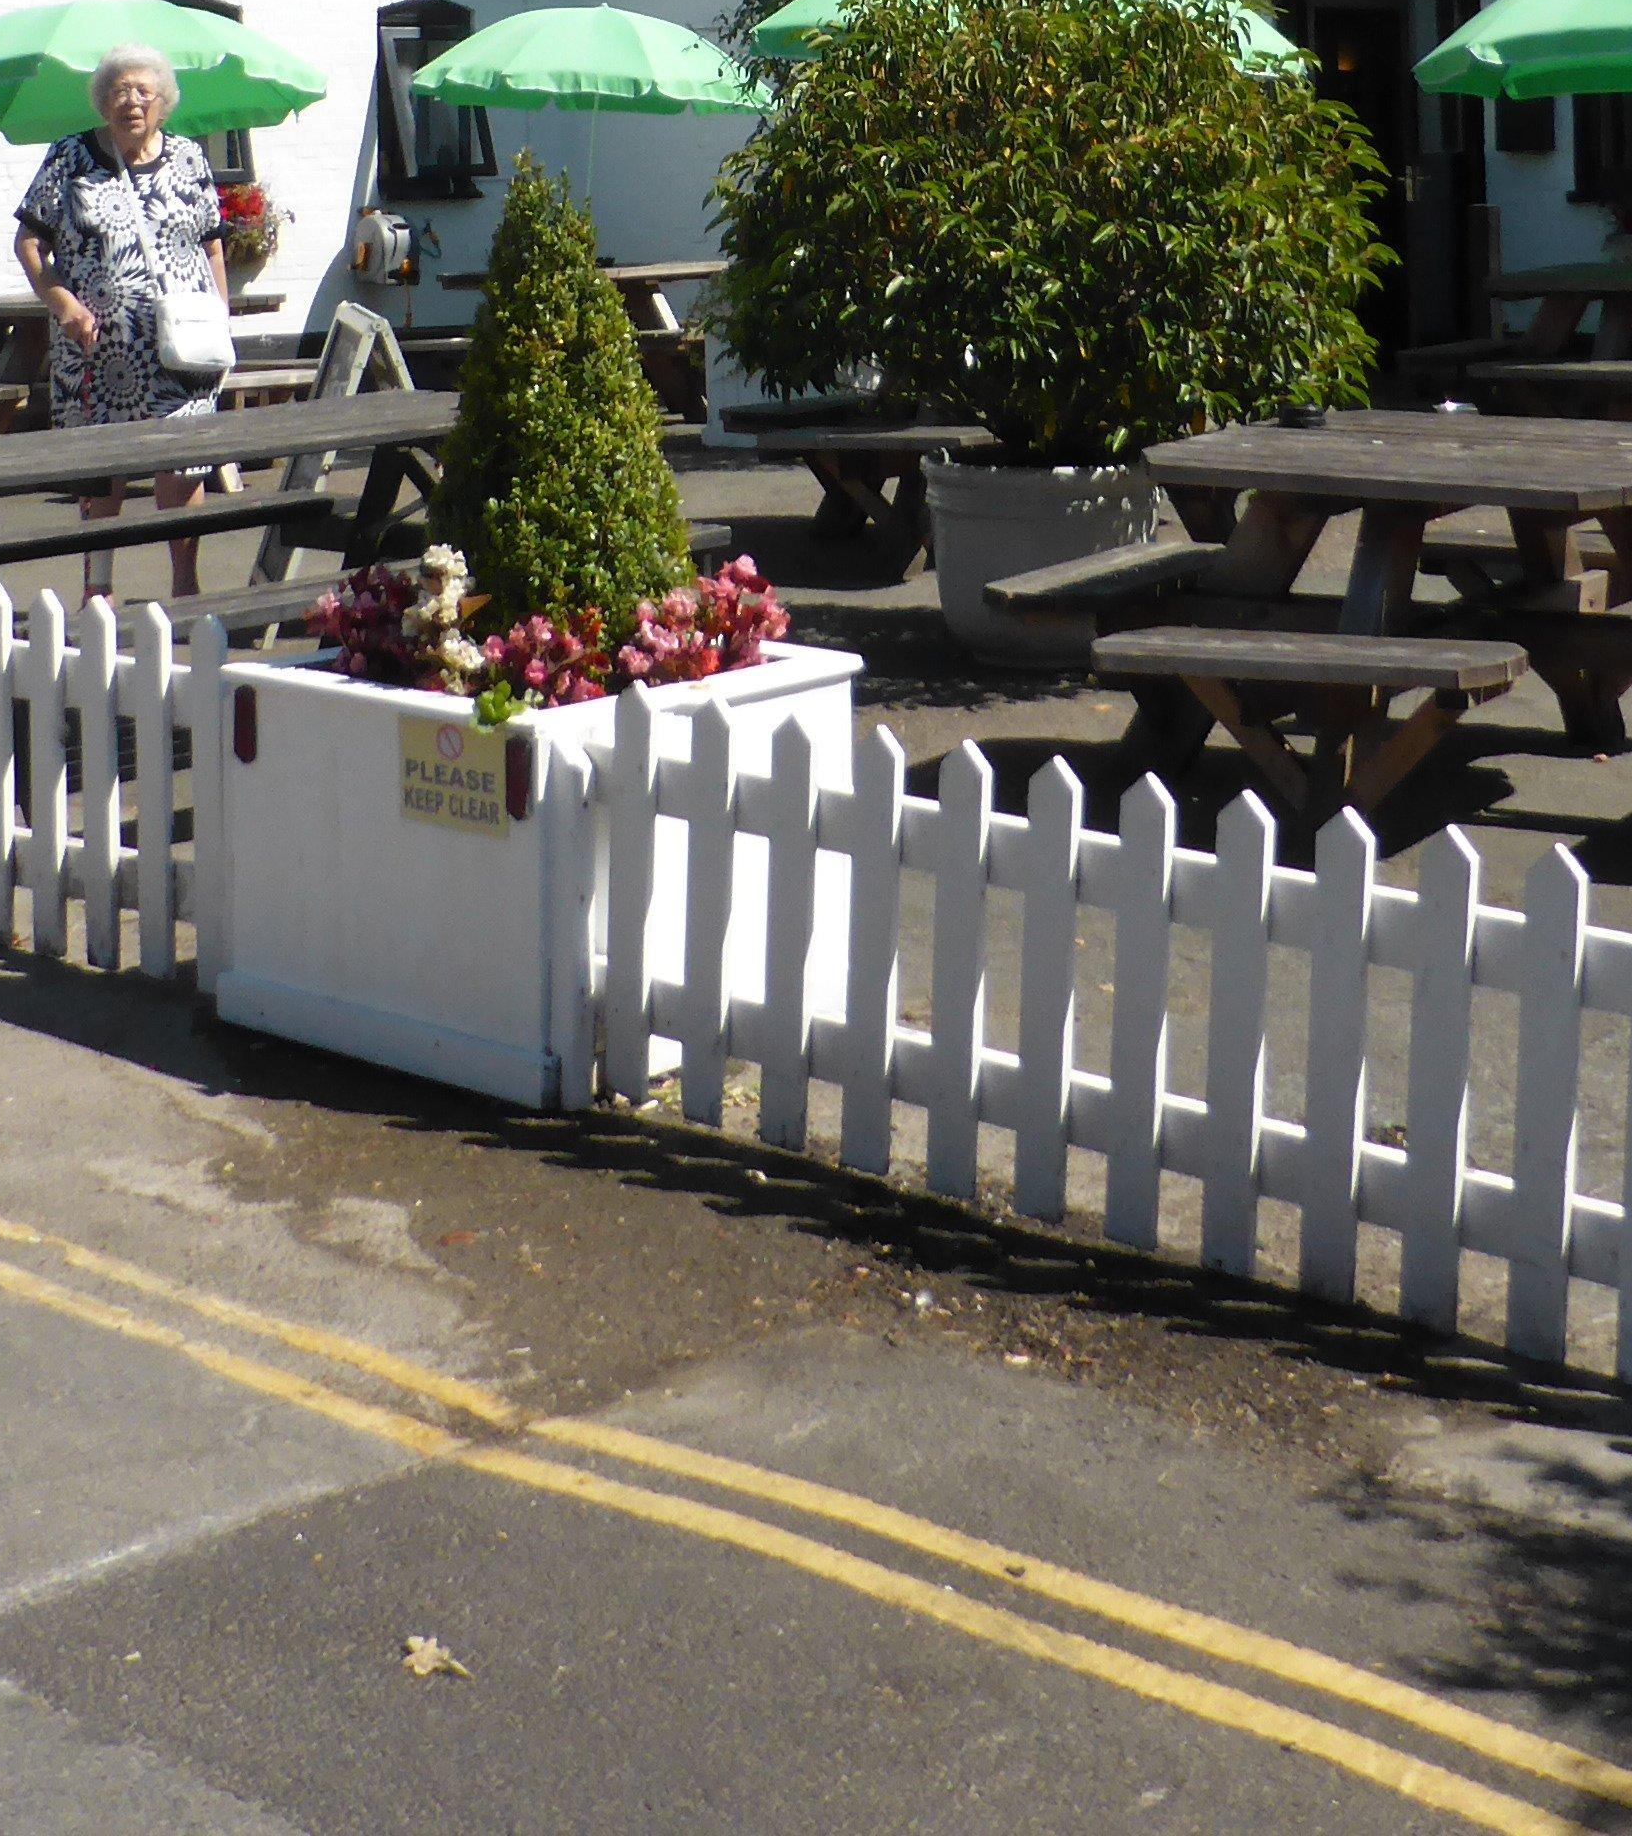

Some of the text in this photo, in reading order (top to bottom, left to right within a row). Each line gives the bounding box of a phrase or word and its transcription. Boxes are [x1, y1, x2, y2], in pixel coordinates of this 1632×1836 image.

[404, 757, 496, 795] PLEASE
[403, 785, 500, 826] KEEP CLEAR
